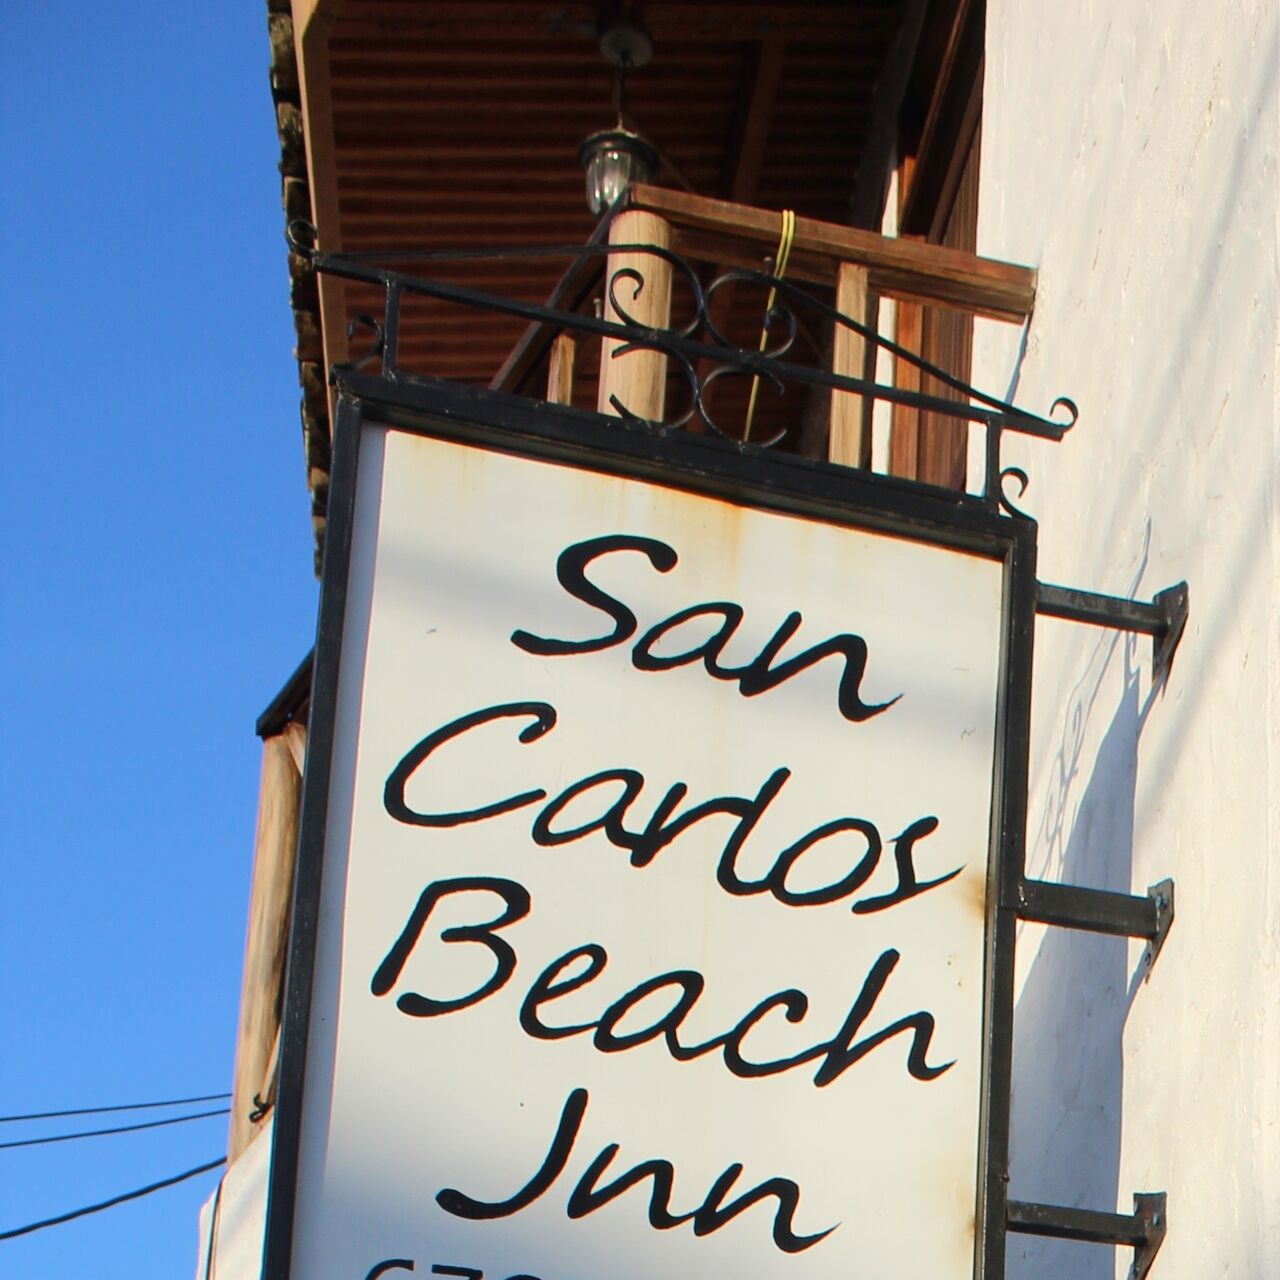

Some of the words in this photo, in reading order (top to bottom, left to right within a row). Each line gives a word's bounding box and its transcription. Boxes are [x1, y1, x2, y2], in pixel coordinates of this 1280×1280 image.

[511, 534, 904, 722] San
[384, 702, 964, 916] Carlos
[371, 875, 957, 1087] Beach
